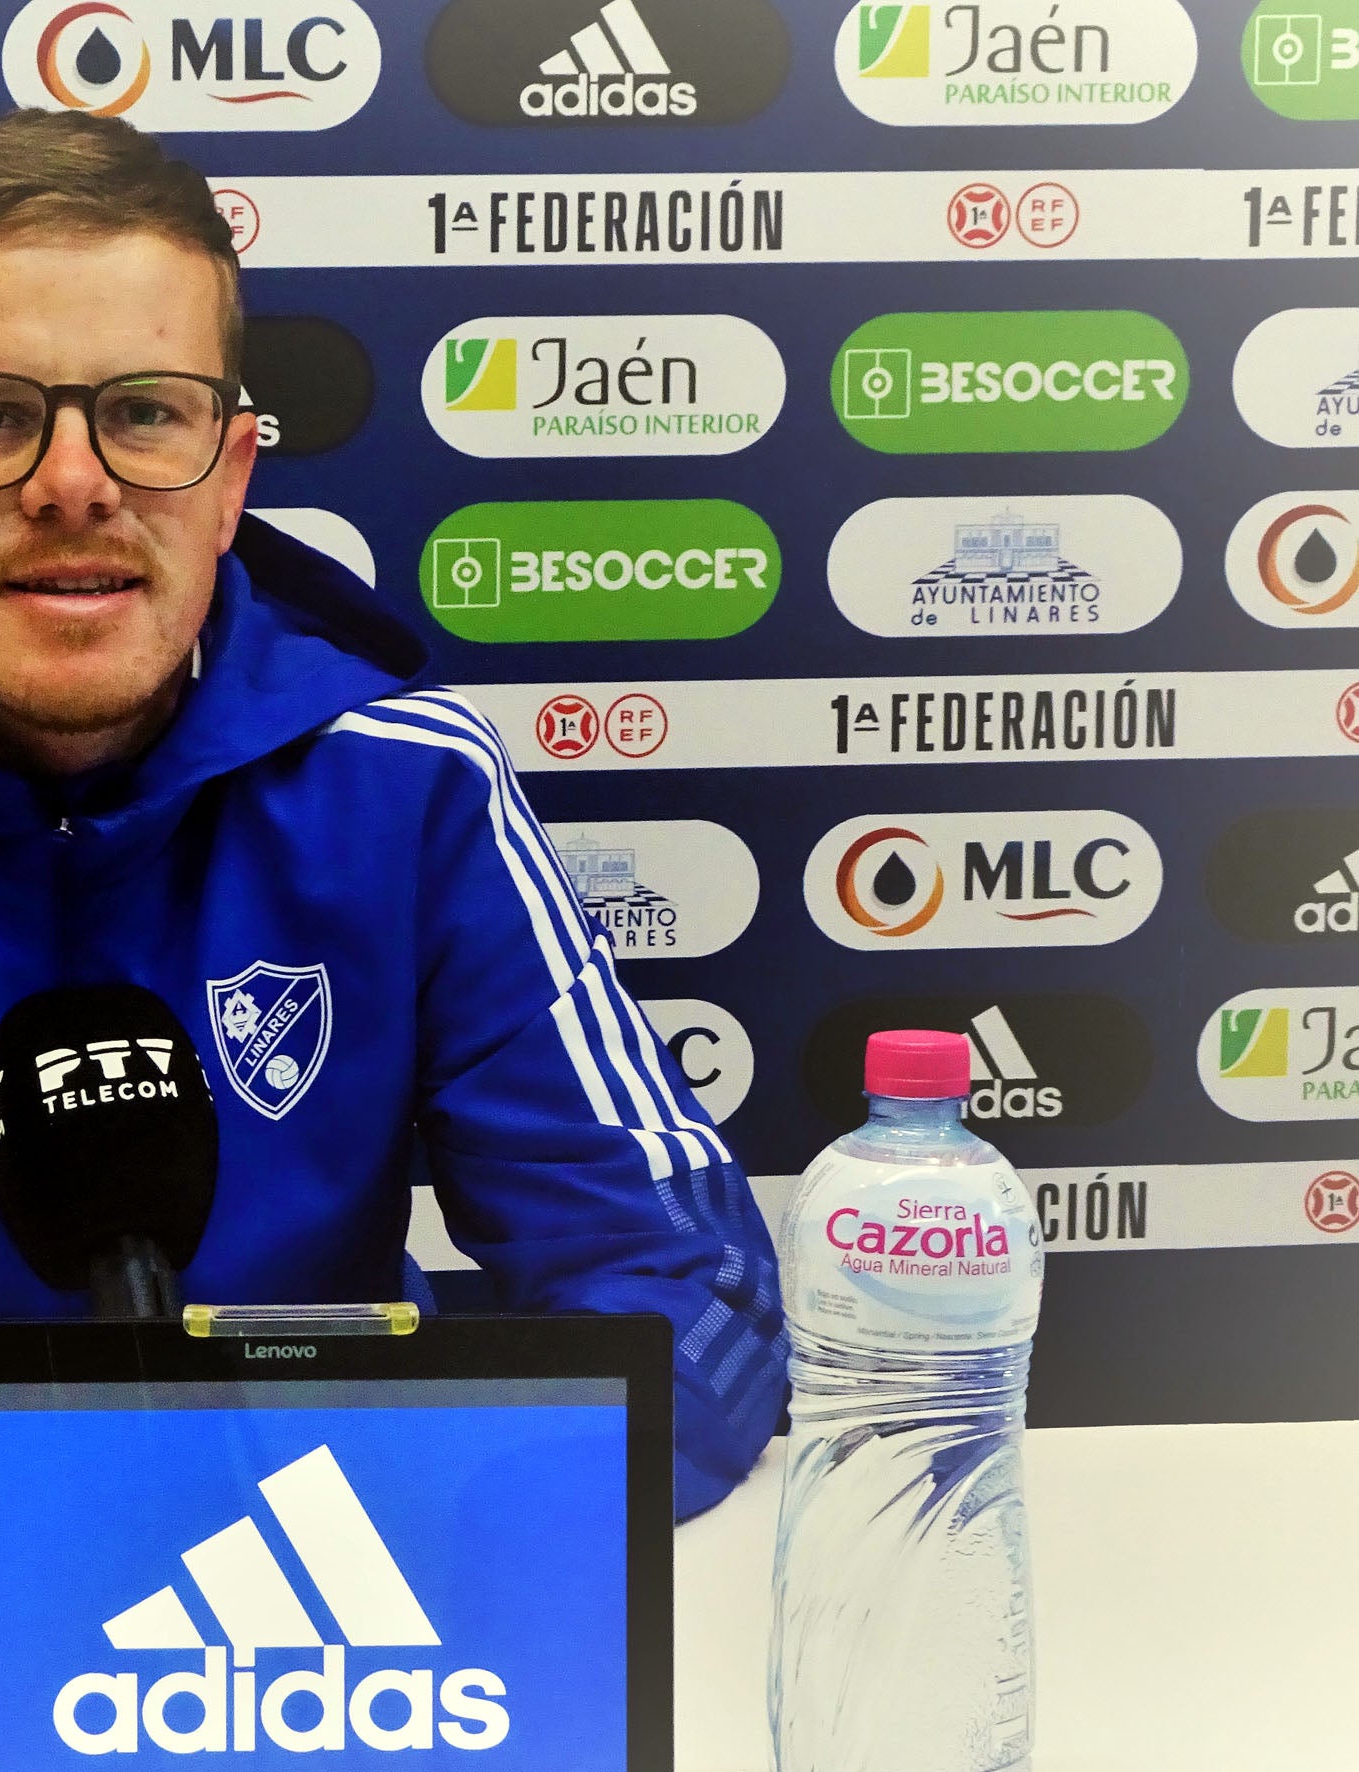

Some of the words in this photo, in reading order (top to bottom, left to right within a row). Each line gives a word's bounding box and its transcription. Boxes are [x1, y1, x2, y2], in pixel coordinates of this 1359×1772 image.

[172, 17, 347, 81] MLC
[945, 4, 1108, 76] Jaén
[520, 73, 696, 118] adidas
[946, 78, 1050, 104] PARAÍSO
[1058, 83, 1171, 103] INTERIOR
[491, 180, 782, 253] FEDERACIÓN
[532, 337, 696, 408] Jaén
[921, 359, 1175, 403] BESOCCER
[534, 409, 637, 436] PARAÍSO
[646, 414, 760, 434] INTERIOR
[1316, 419, 1341, 436] de
[511, 548, 767, 592] BESOCCER
[911, 608, 937, 625] de
[971, 605, 1099, 624] LINARES
[913, 584, 1099, 604] AYUNTAMIENTO
[891, 679, 1175, 752] FEDERACIÓN
[964, 838, 1130, 900] MLC
[244, 998, 298, 1067] LINARES
[42, 1080, 179, 1114] TELECOM
[897, 1199, 966, 1220] Sierra
[826, 1207, 1009, 1258] Cazorla
[841, 1254, 882, 1273] Agua
[890, 1259, 952, 1276] Mineral
[958, 1258, 1011, 1276] Natural
[245, 1343, 317, 1358] Lenovo
[52, 1644, 510, 1754] adidas
